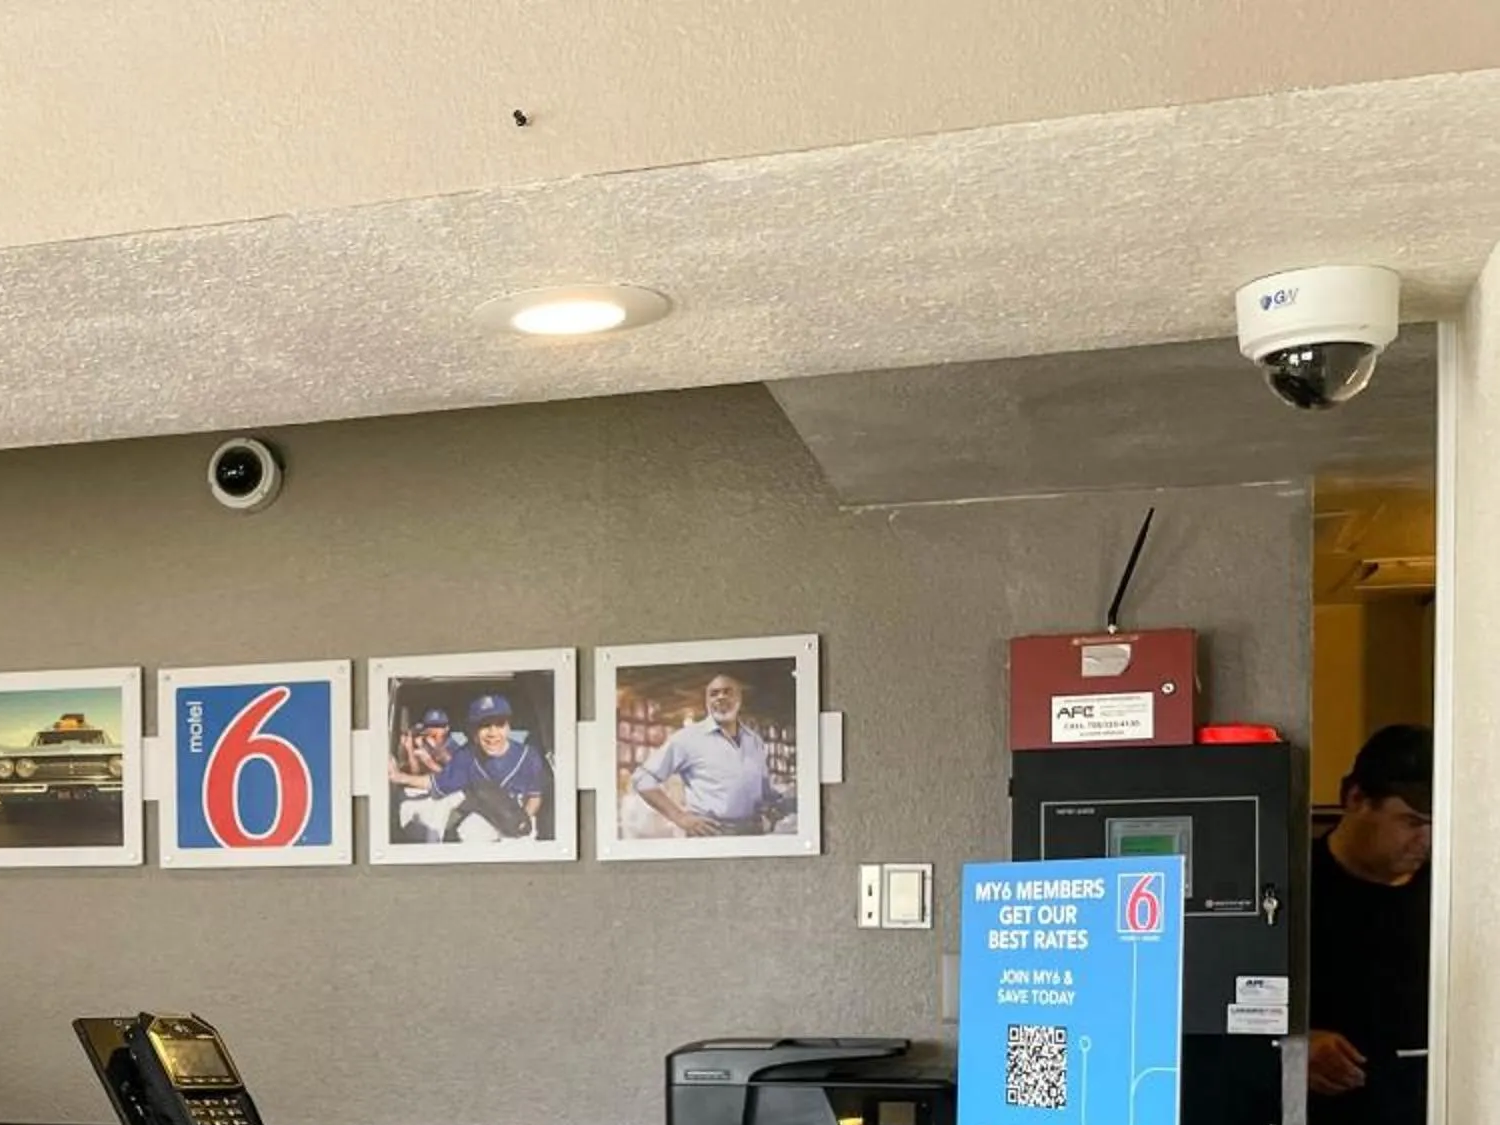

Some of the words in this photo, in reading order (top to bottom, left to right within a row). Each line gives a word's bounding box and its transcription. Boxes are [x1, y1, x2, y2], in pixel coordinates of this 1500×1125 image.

[1057, 705, 1095, 719] AFC
[186, 701, 204, 753] motel
[202, 686, 313, 850] 6
[976, 881, 1012, 901] MY6
[1016, 878, 1105, 900] MEMBERS
[1127, 874, 1160, 932] 6
[1000, 905, 1035, 925] GET
[1038, 905, 1077, 925] OUR
[988, 930, 1030, 950] BEST
[1034, 929, 1088, 950] RATES
[1000, 969, 1029, 985] JOIN
[1033, 969, 1060, 985] MY6
[1063, 970, 1073, 985] &
[997, 989, 1029, 1004] SAVE
[1032, 989, 1075, 1006] TODAY
